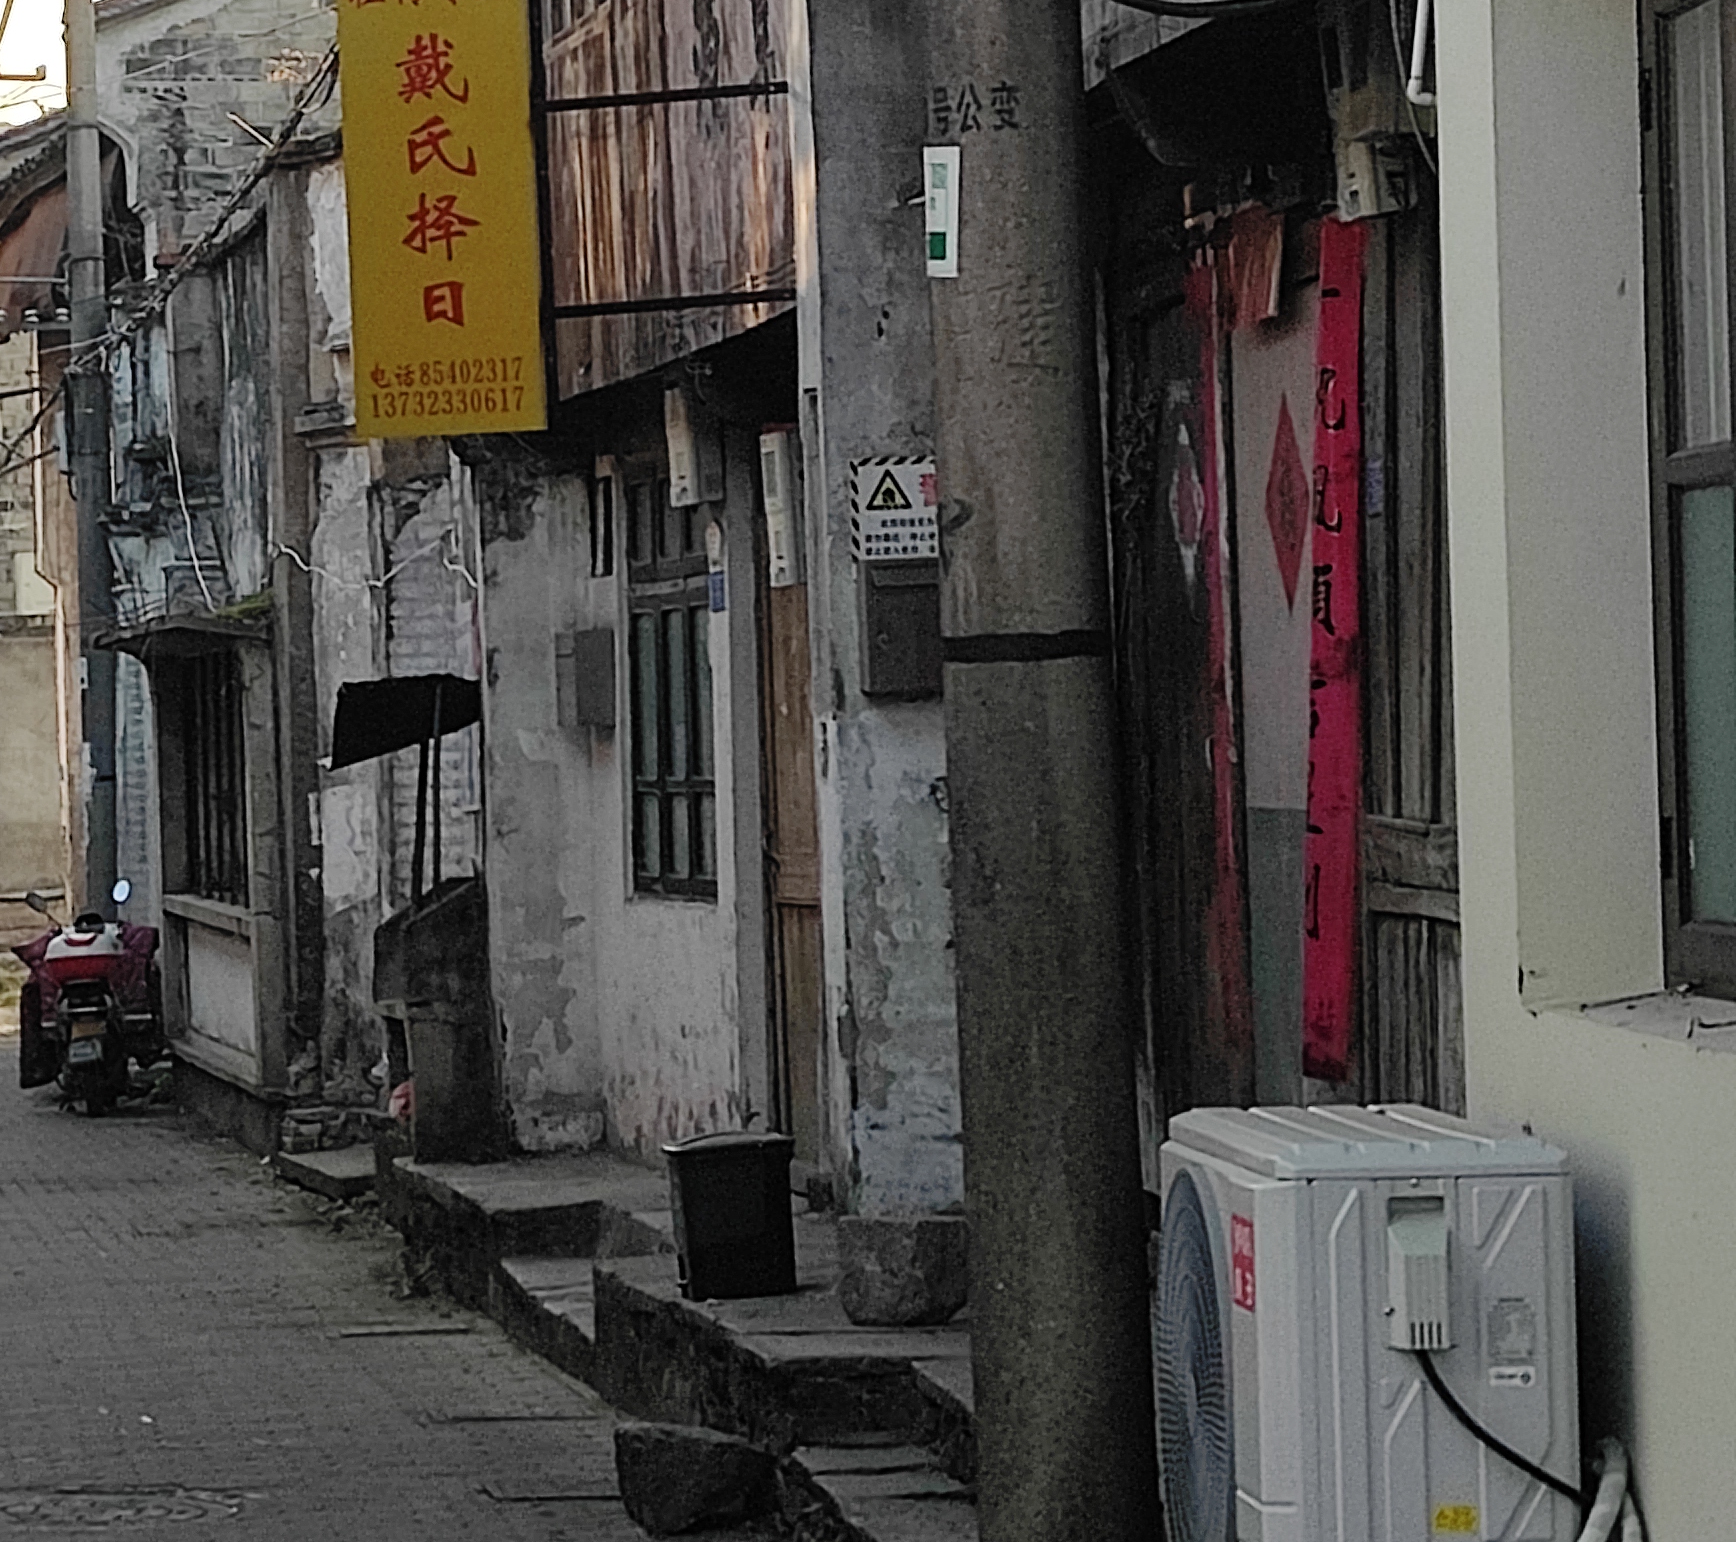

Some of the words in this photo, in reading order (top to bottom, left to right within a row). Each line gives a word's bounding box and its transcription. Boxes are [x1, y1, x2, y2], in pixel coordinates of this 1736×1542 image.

[395, 32, 481, 327] 戴氏择日
[371, 386, 524, 419] 13732330617
